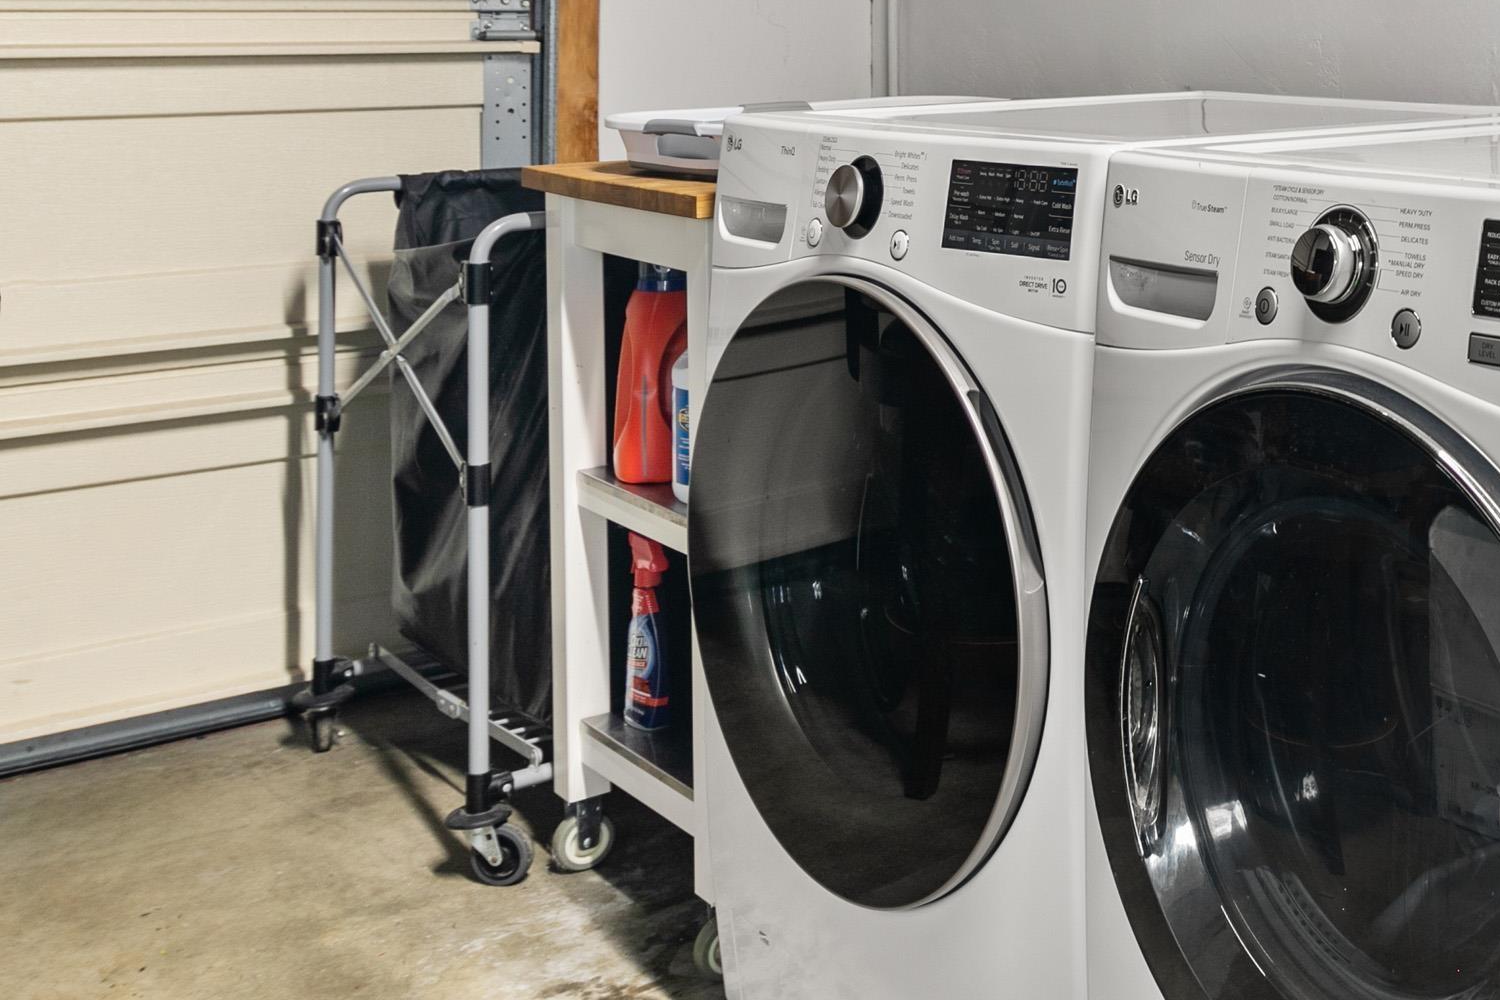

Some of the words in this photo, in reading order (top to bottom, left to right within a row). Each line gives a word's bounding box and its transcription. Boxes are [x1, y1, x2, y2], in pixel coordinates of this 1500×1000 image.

[781, 145, 795, 156] ThinQ
[1400, 208, 1417, 216] HEAVY
[1400, 235, 1429, 245] DELICATES
[1184, 249, 1207, 263] Sensor
[1208, 253, 1221, 268] Dry
[1404, 252, 1426, 261] TOWELS
[1395, 269, 1412, 278] SPEED
[1413, 271, 1424, 279] DRY
[1052, 278, 1067, 294] 10
[1481, 342, 1494, 350] DRY
[1478, 351, 1497, 360] LEVEL
